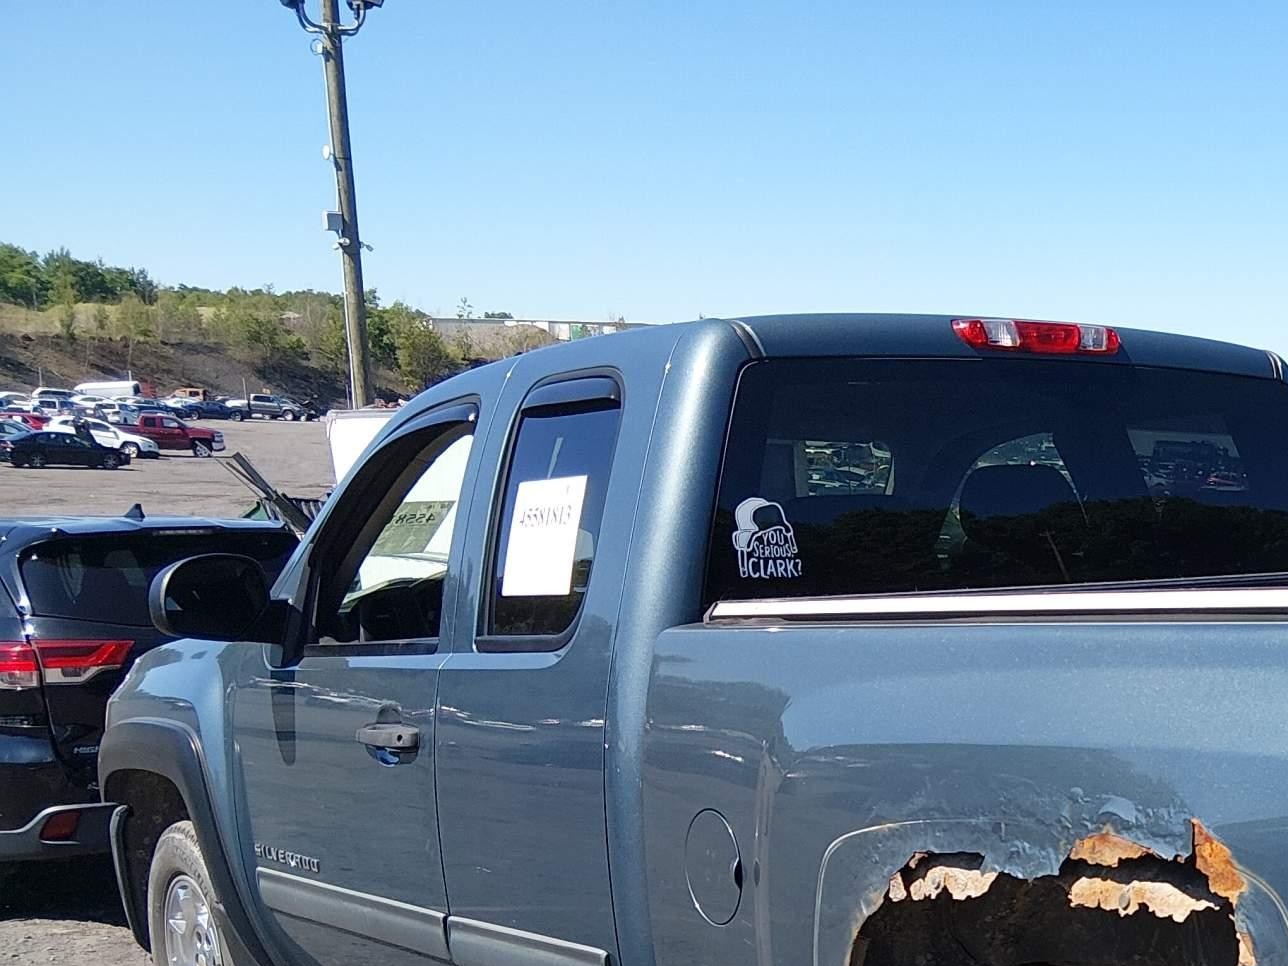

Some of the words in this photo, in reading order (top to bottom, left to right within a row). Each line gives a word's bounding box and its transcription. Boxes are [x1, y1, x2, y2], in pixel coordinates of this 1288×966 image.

[762, 530, 785, 546] YOU
[748, 558, 802, 579] CLARK?
[254, 843, 320, 873] SILVERADO
